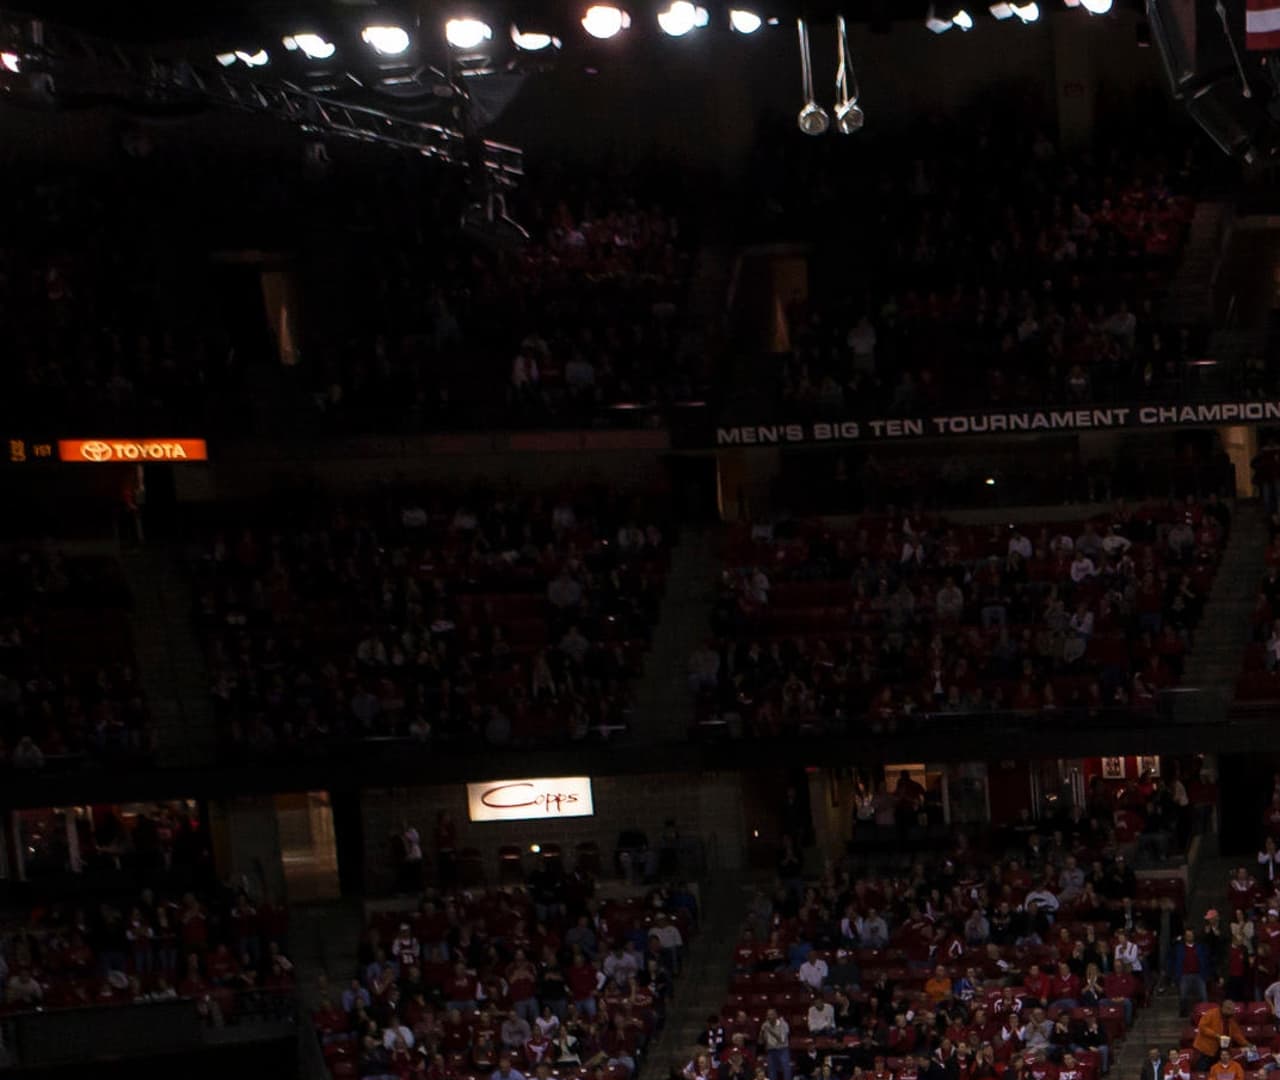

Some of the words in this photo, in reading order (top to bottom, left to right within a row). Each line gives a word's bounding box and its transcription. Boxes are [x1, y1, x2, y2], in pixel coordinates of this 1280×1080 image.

[715, 424, 802, 445] MEN'S
[812, 421, 860, 441] BIG
[868, 417, 924, 438] TEN
[931, 407, 1129, 434] TOURNAMENT
[111, 443, 187, 459] TOYOTA
[481, 783, 579, 813] Copps
